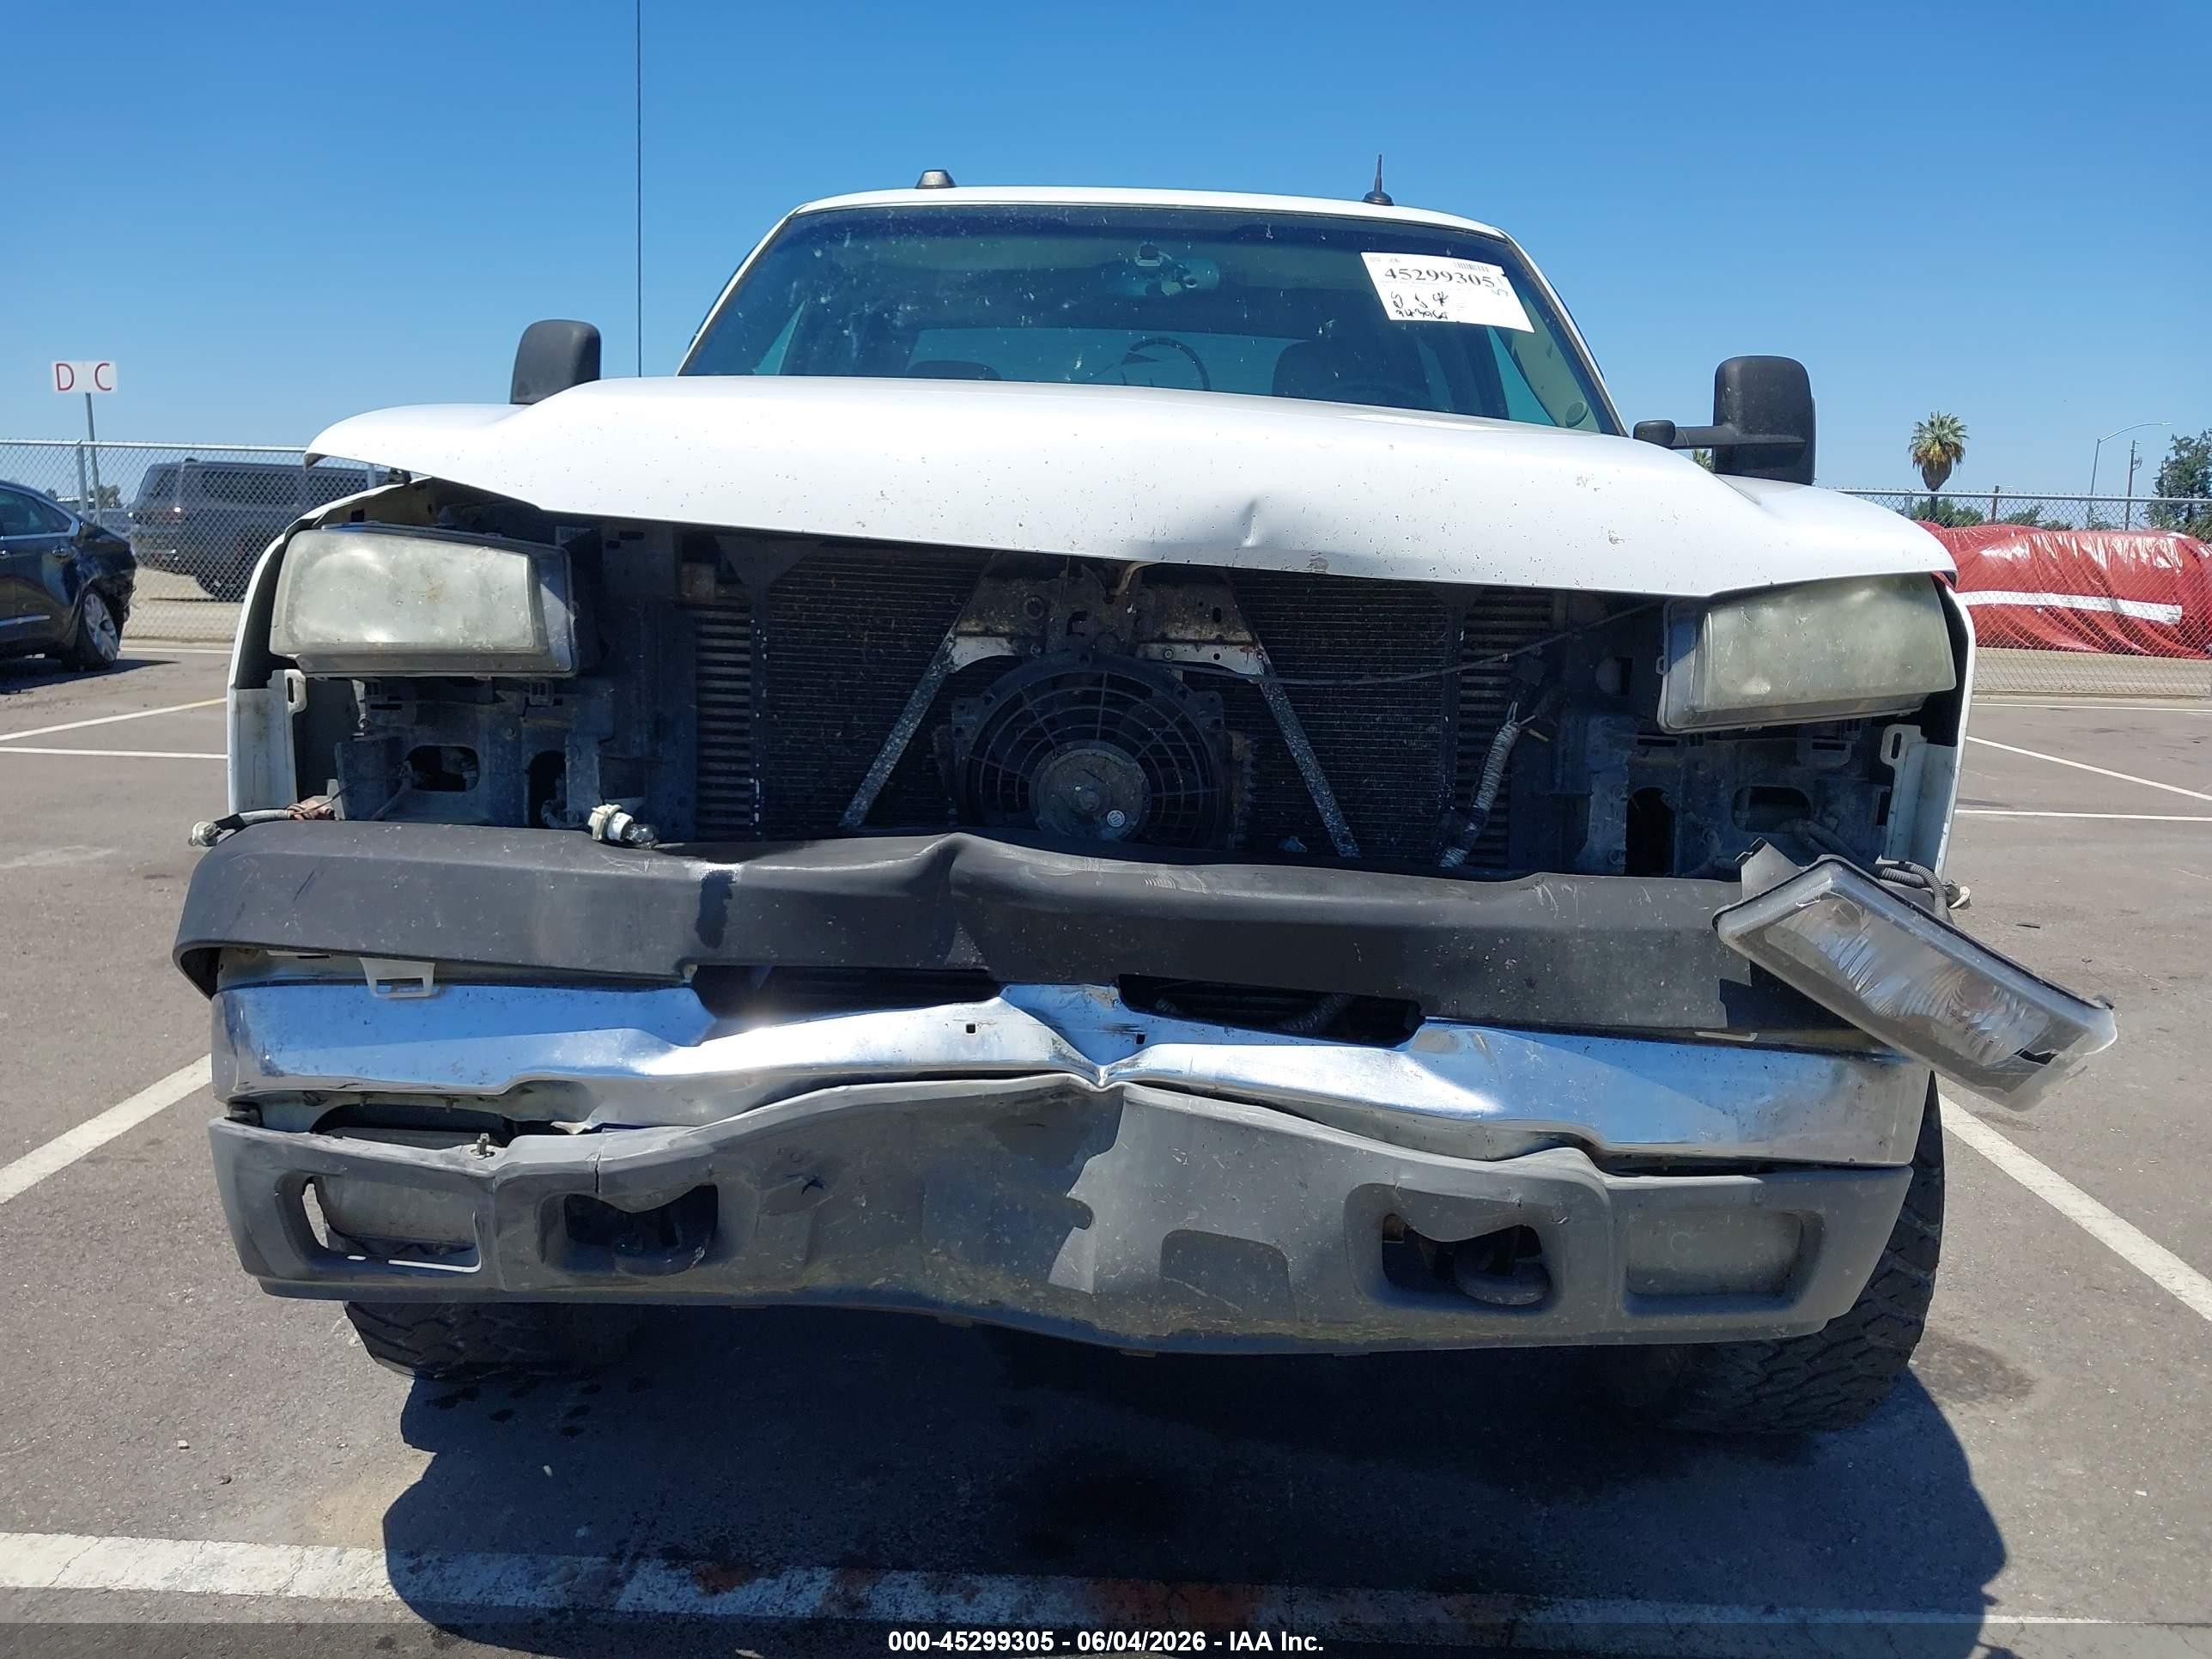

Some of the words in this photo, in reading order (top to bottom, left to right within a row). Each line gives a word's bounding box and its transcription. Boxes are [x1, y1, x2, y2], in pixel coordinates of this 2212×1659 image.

[1384, 267, 1495, 289] 45299305
[56, 363, 75, 391] D
[94, 362, 112, 391] C
